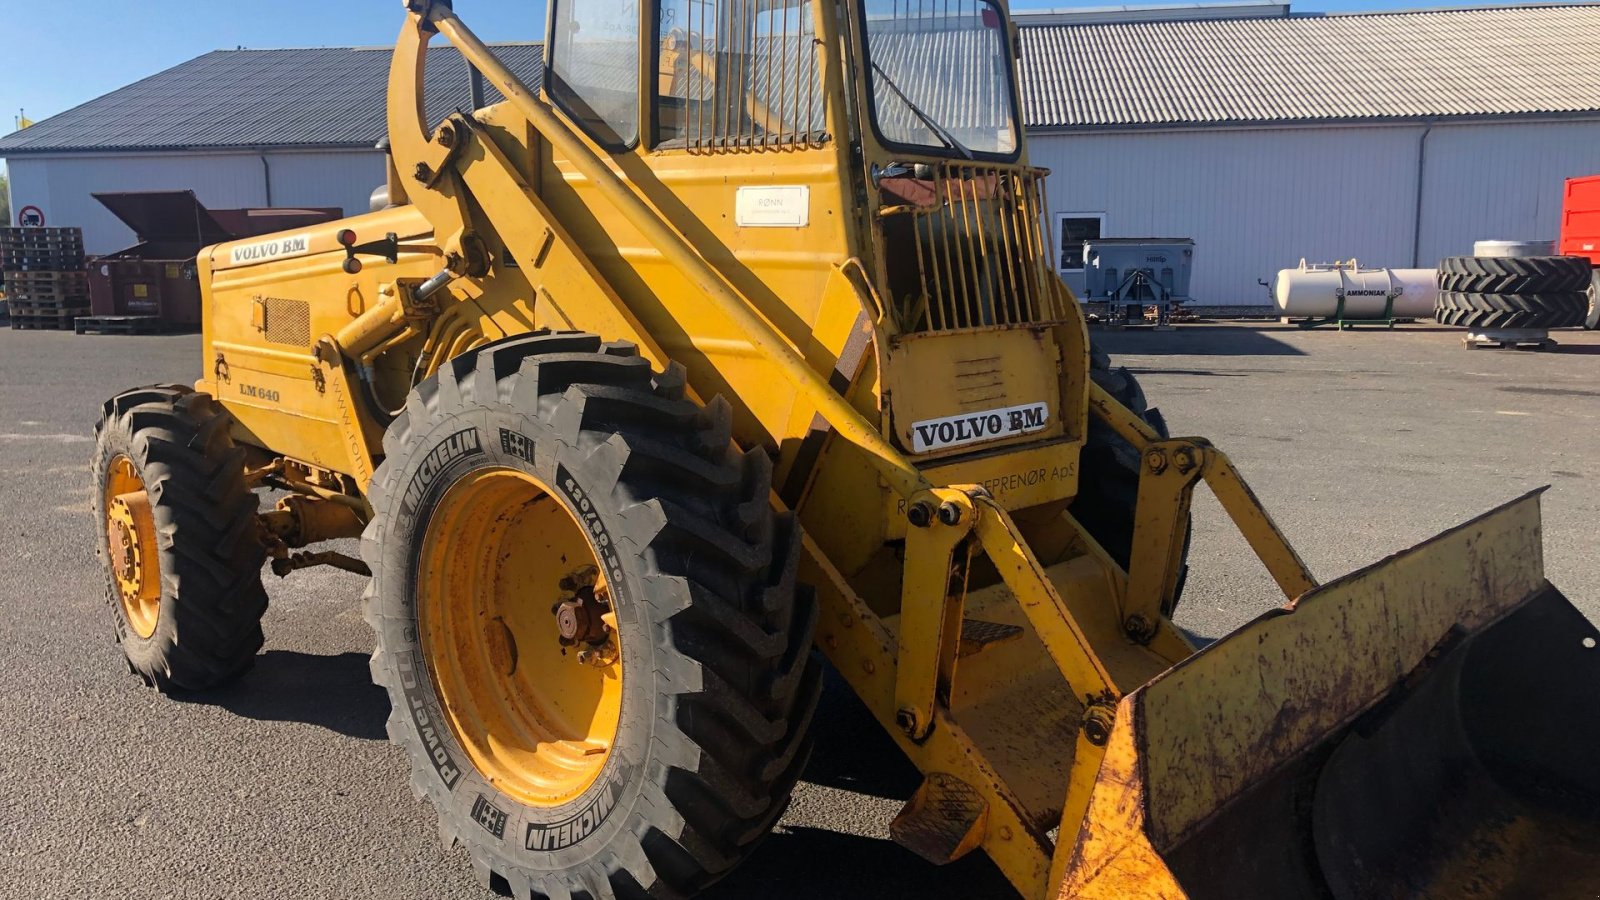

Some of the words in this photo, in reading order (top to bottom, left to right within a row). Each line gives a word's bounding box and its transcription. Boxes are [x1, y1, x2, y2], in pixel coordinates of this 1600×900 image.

[234, 242, 278, 261] VOLVO
[281, 238, 306, 254] BM
[1346, 289, 1386, 297] AMMONIAK
[239, 383, 257, 397] LM
[258, 387, 280, 402] 640
[915, 414, 1002, 447] VOLVO
[1007, 406, 1044, 432] BM
[403, 428, 477, 513] MICHELIN
[1050, 462, 1075, 481] ApS
[411, 696, 459, 785] Power
[527, 786, 616, 850] MICHELIN
